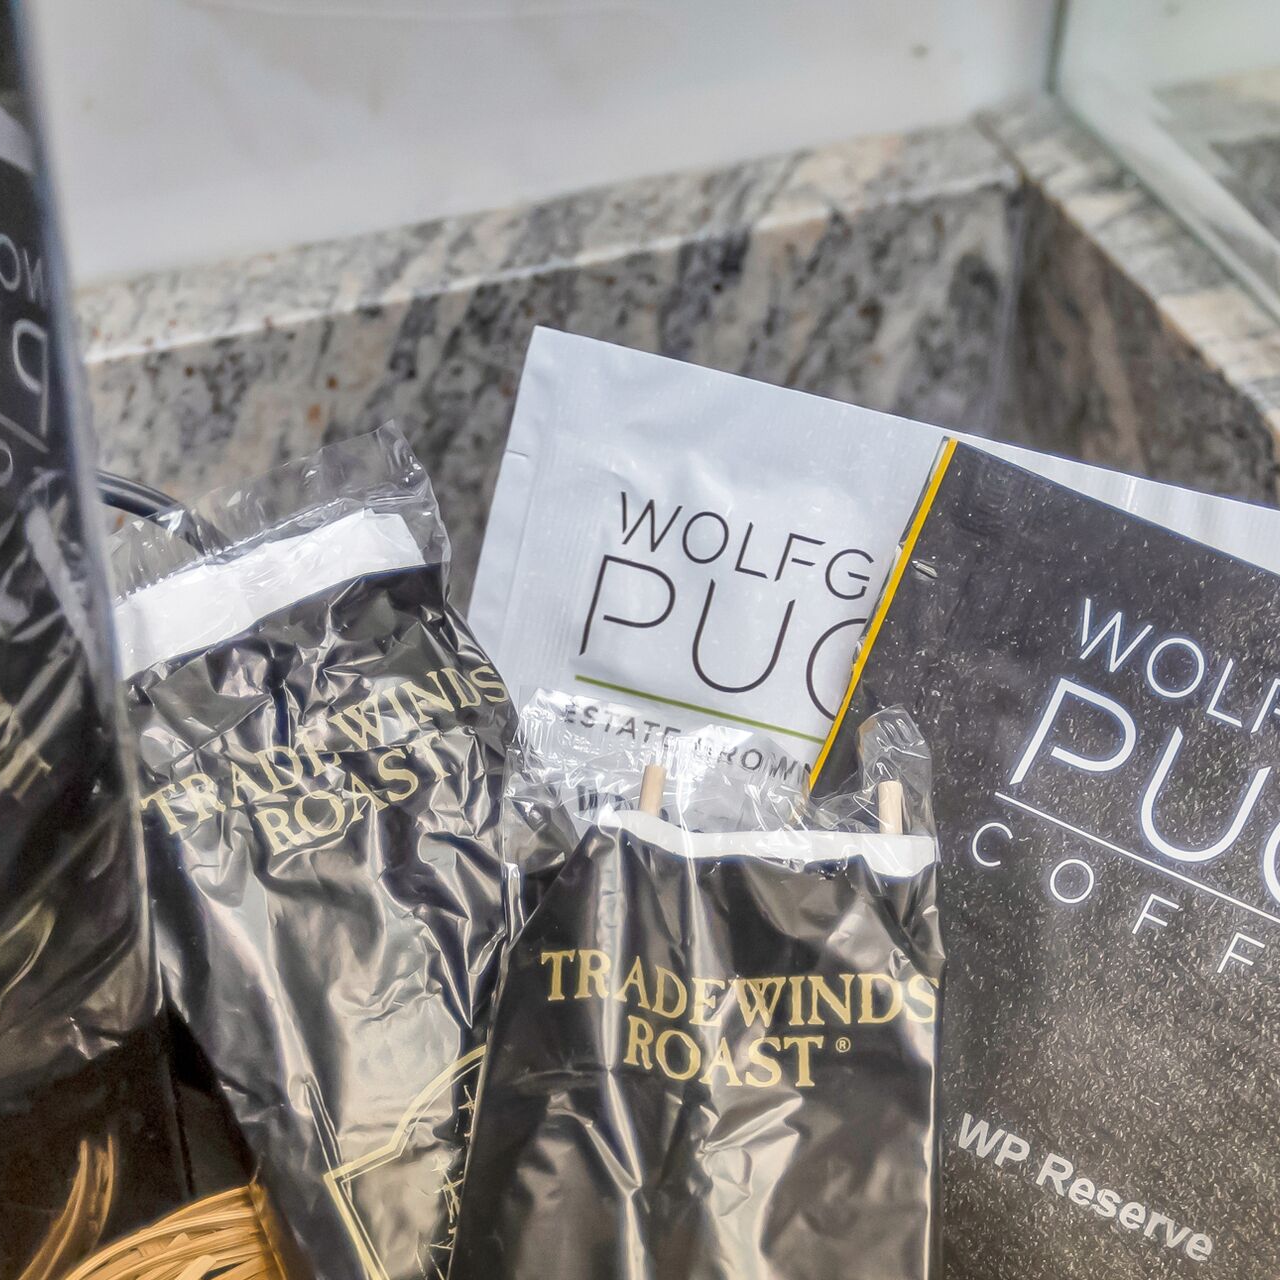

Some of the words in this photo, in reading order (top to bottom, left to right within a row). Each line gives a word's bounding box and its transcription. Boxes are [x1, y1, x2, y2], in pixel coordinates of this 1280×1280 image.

[618, 491, 875, 601] WOLFG
[254, 731, 451, 856] ROAST
[957, 1112, 1030, 1167] WP
[1035, 1152, 1214, 1263] Reserve
